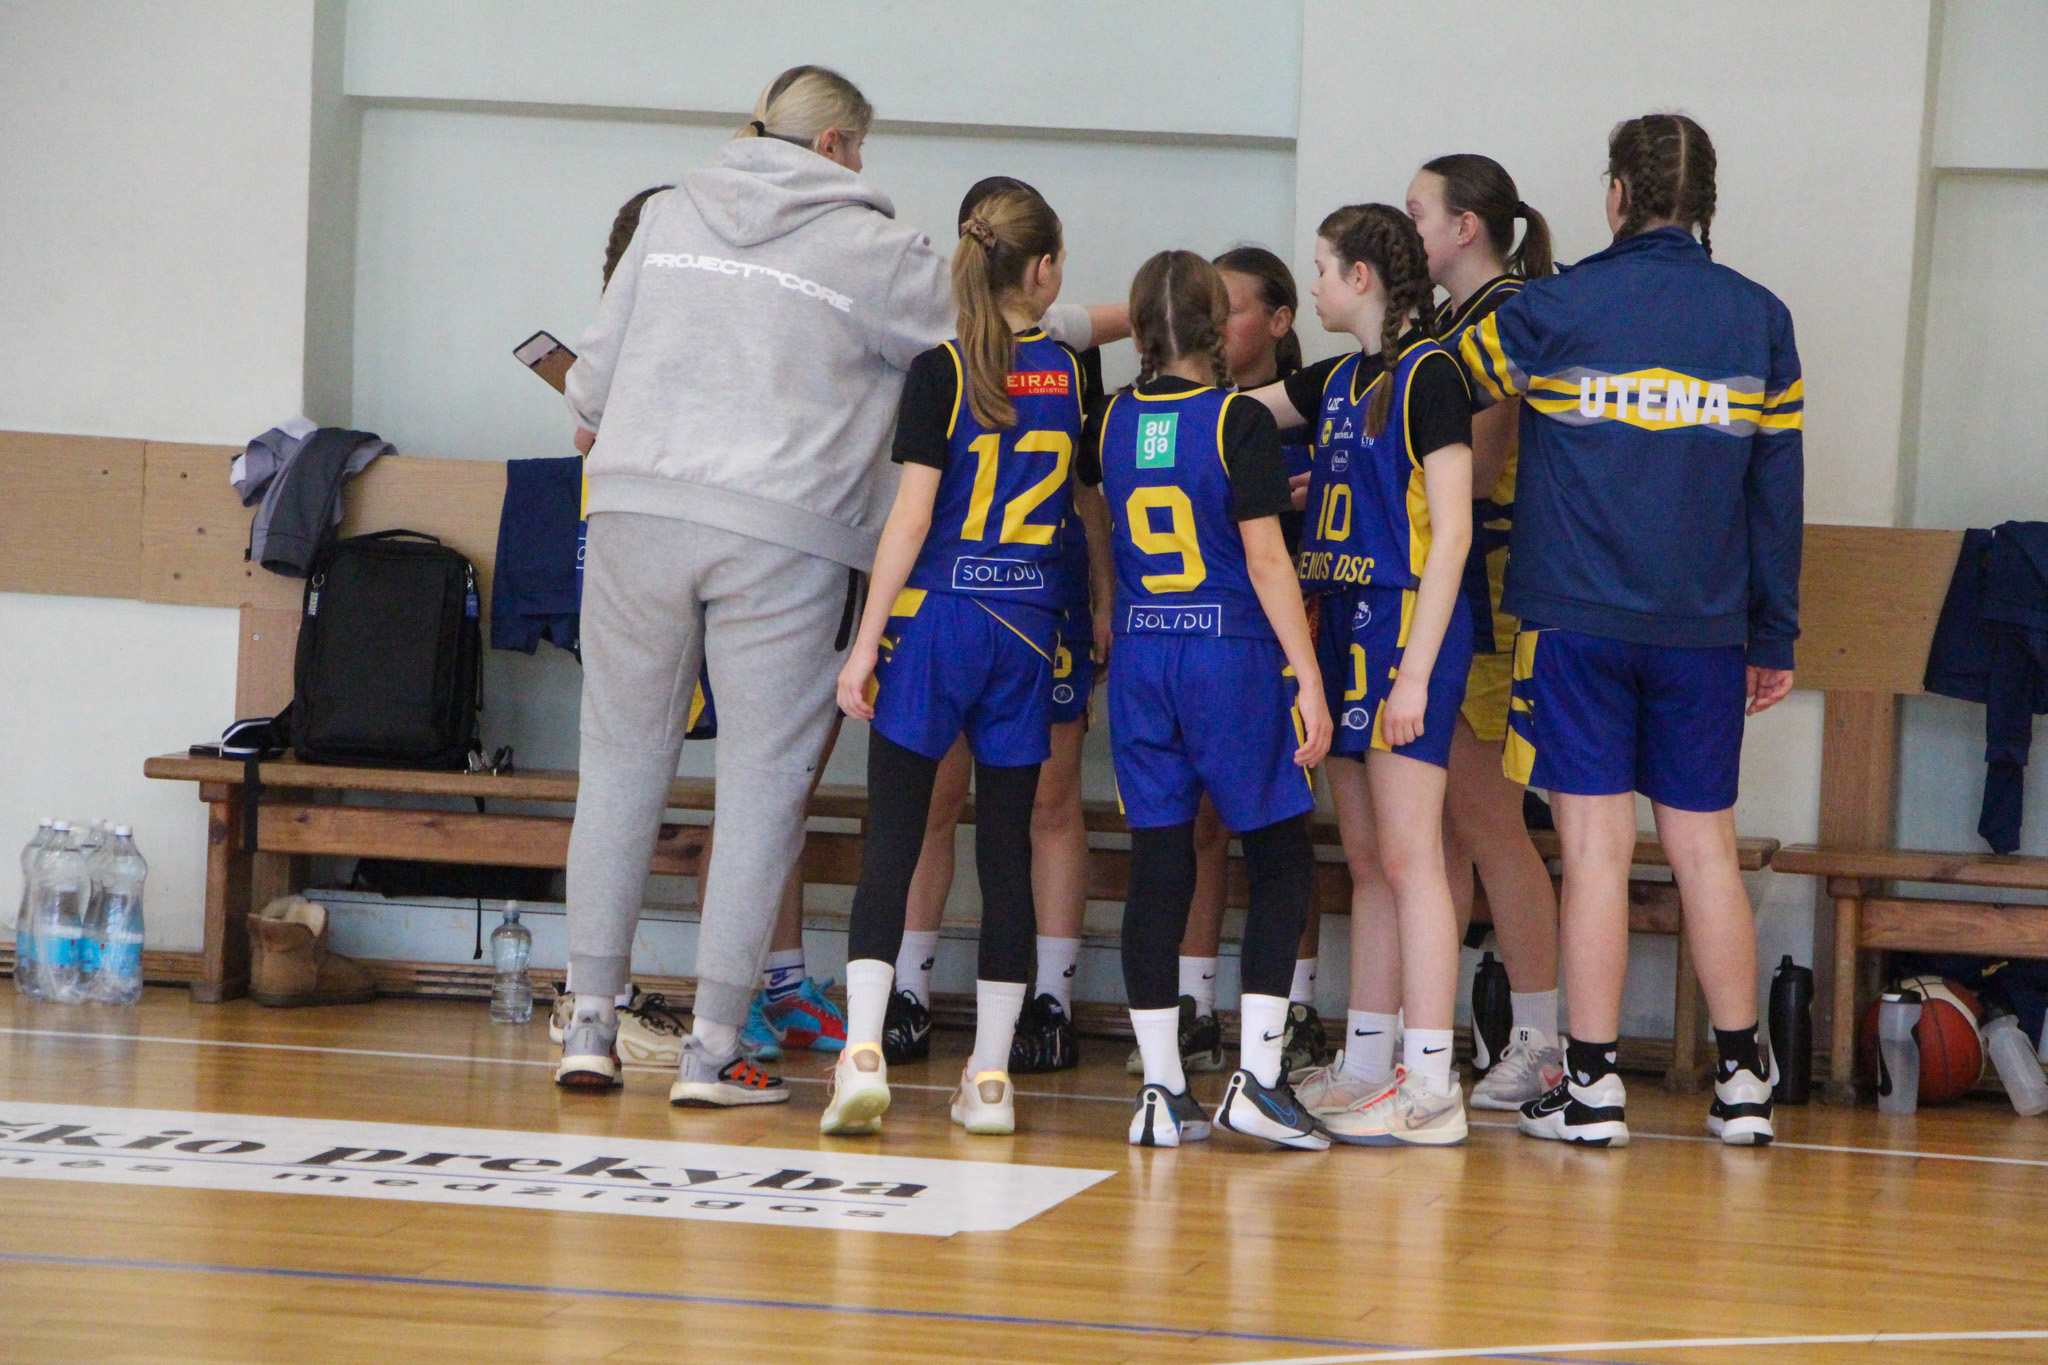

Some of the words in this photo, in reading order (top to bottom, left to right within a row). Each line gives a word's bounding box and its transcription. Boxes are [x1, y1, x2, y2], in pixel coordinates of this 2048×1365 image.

[1579, 376, 1731, 426] UTENA
[960, 430, 1073, 545] 12
[1316, 483, 1352, 542] 10
[1126, 485, 1207, 594] 9
[1333, 554, 1375, 585] DSC
[272, 1173, 887, 1218] medžiagos
[290, 1147, 928, 1198] prekyba
